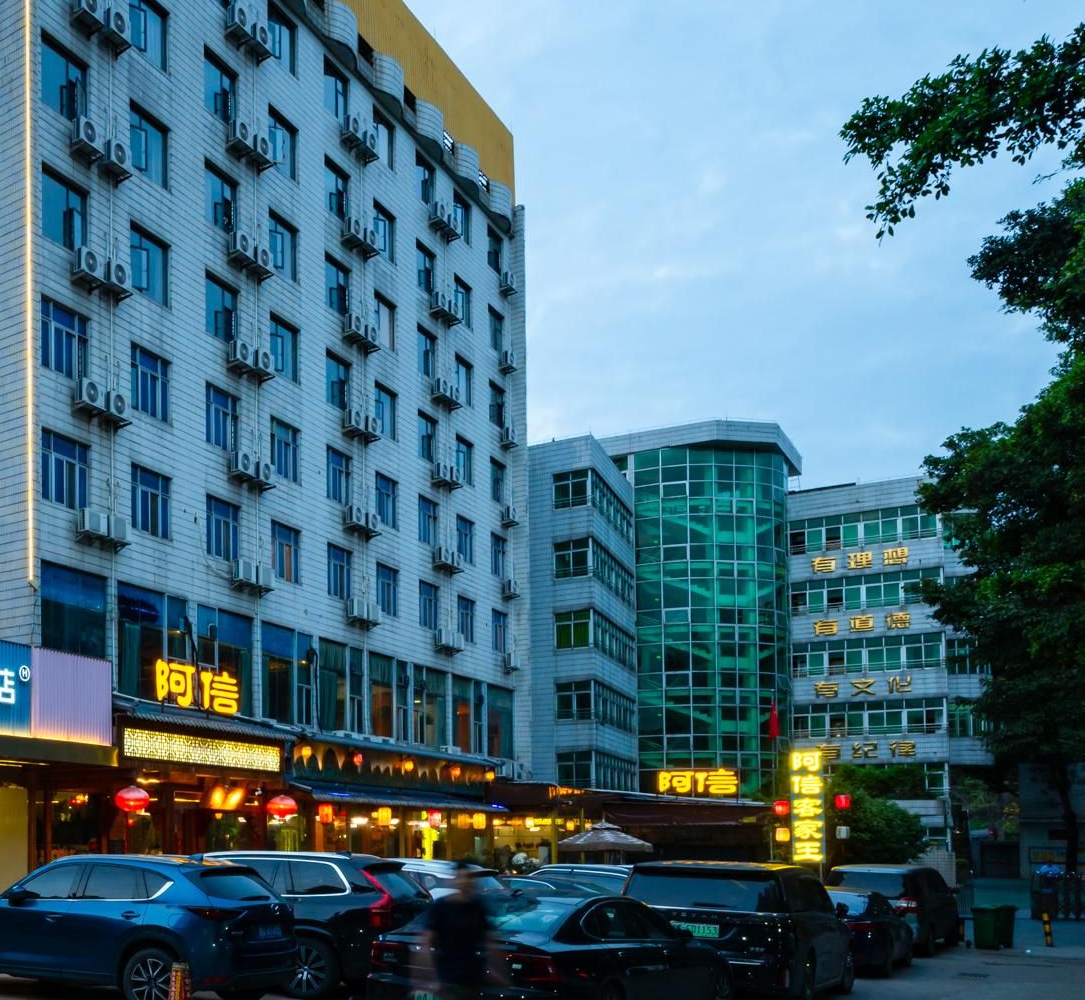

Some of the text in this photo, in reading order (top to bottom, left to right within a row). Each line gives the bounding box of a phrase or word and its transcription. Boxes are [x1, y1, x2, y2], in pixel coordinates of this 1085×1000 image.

[811, 547, 909, 573] 有理想
[813, 612, 911, 635] 有道德
[154, 658, 240, 715] 阿信
[814, 675, 913, 697] 有文化
[816, 740, 916, 760] 有纪律
[657, 768, 739, 795] 阿信
[790, 751, 824, 862] 阿信客家王
